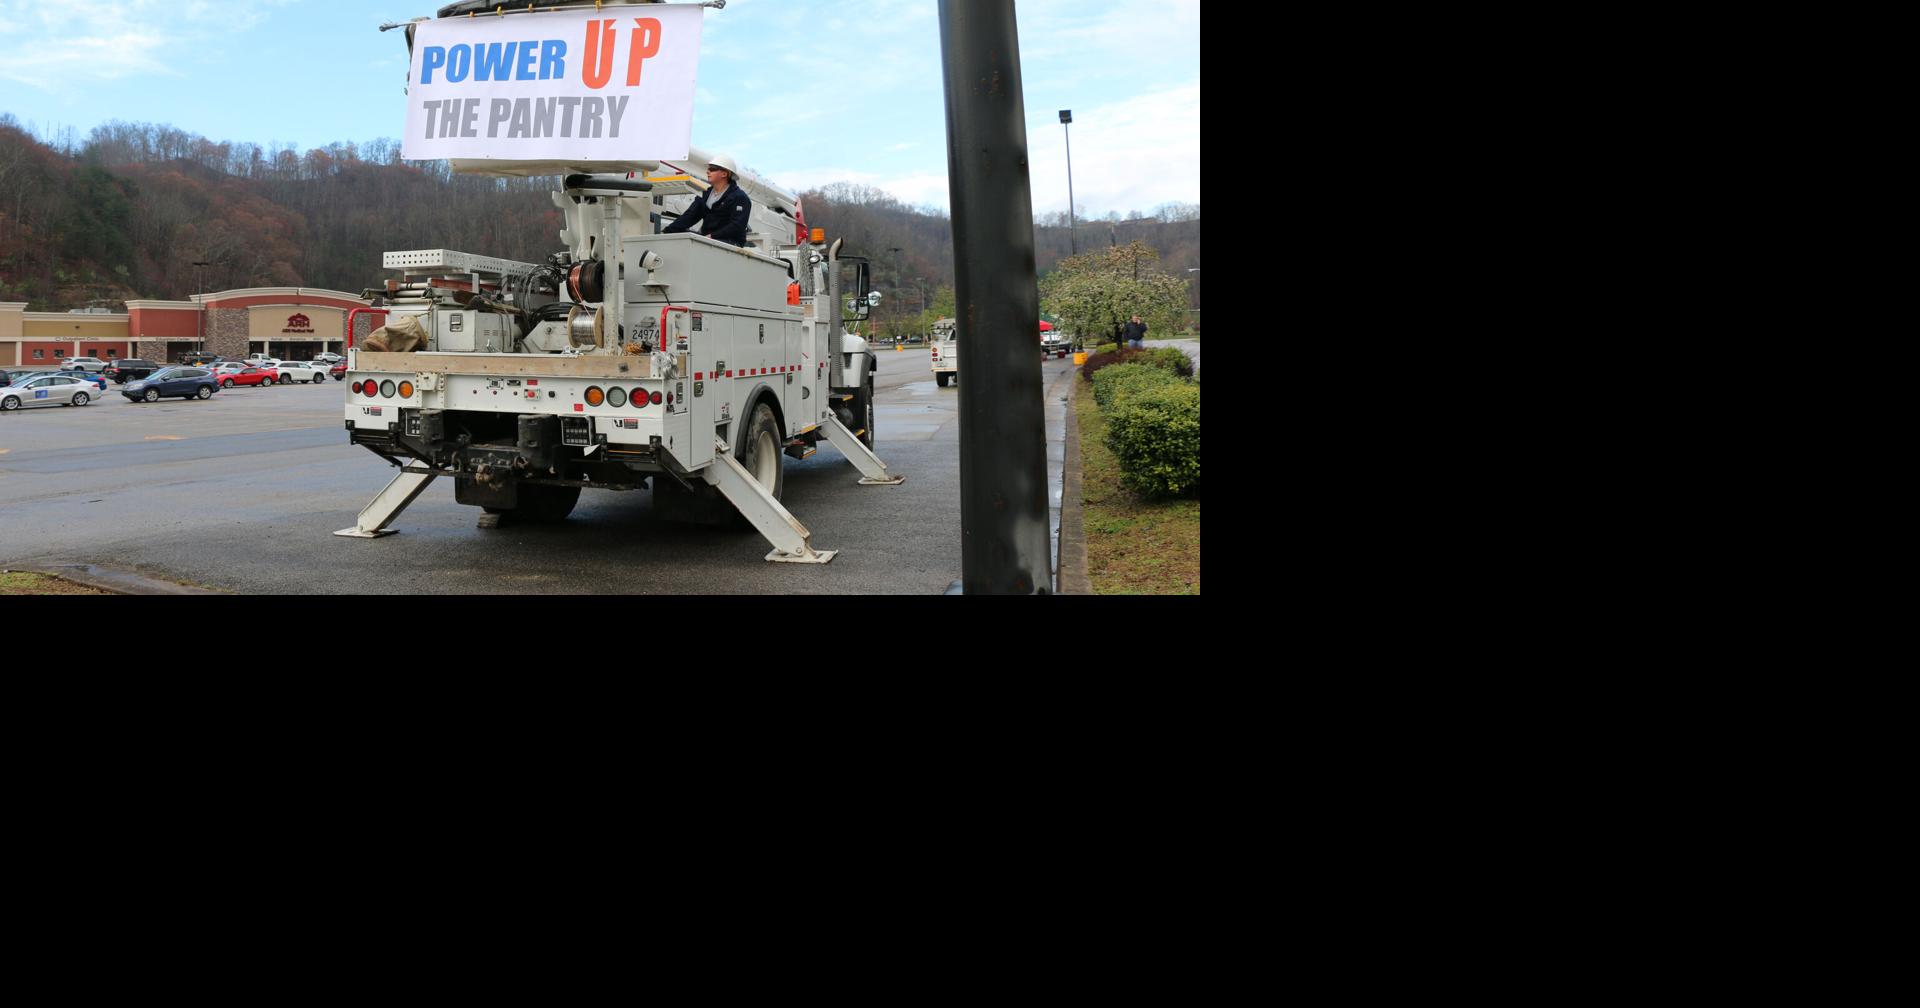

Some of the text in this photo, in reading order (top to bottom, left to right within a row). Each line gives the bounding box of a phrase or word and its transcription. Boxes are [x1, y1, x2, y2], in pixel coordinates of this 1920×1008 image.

[420, 17, 661, 89] POWER UP
[423, 95, 629, 139] THE PANTRY
[632, 329, 659, 339] 24974
